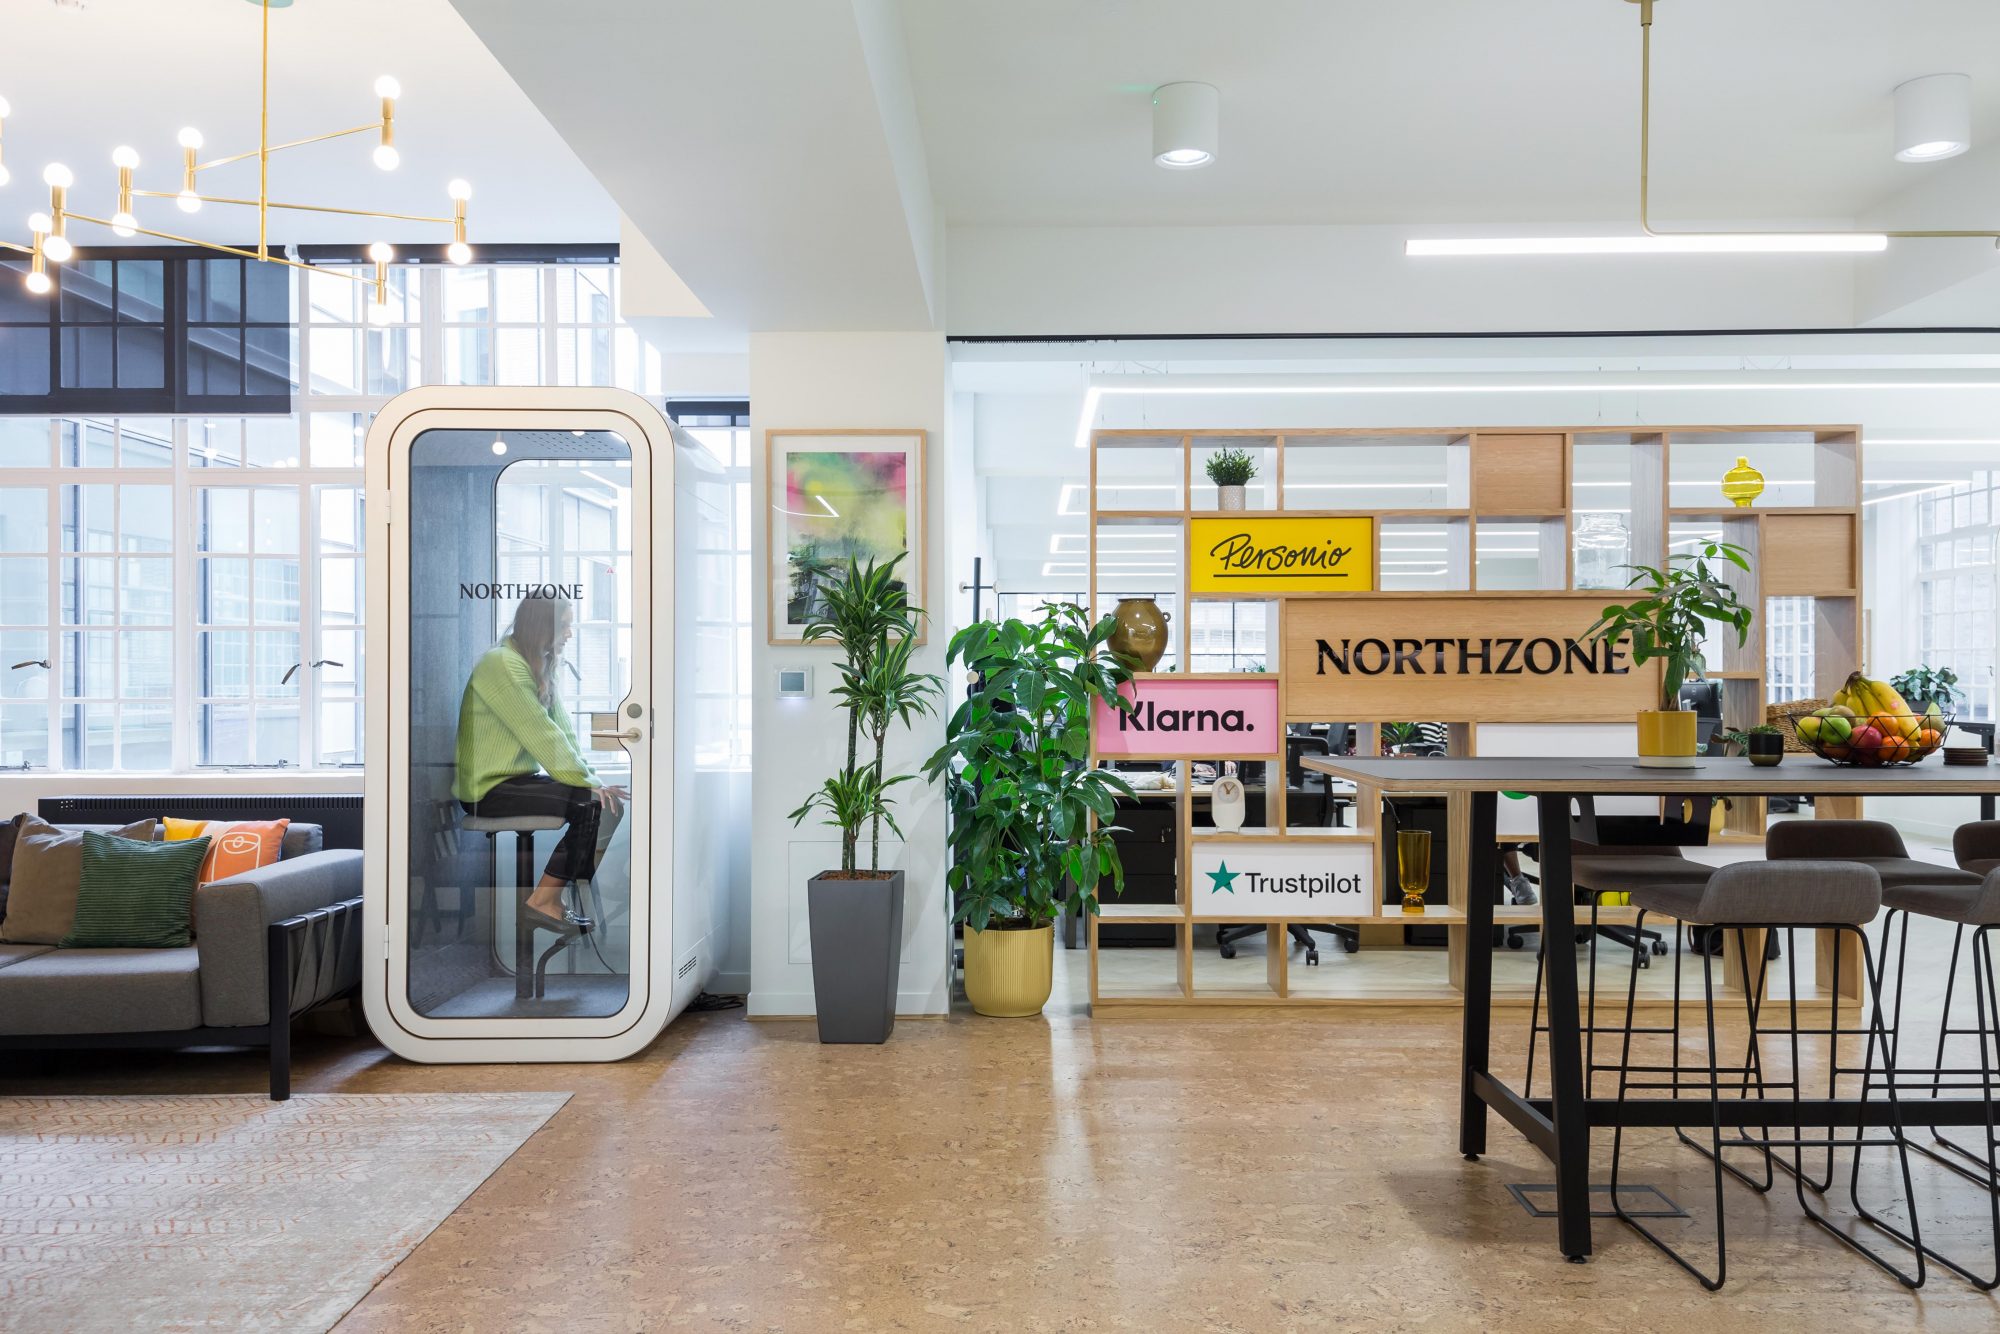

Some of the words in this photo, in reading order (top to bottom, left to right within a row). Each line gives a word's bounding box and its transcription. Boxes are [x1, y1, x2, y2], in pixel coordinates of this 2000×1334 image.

[1210, 533, 1352, 570] Personio
[460, 583, 583, 600] NORTHZONE
[1316, 637, 1630, 675] NORTHZONE
[1119, 701, 1255, 732] Klarna.
[1245, 872, 1361, 898] Trustpilot
